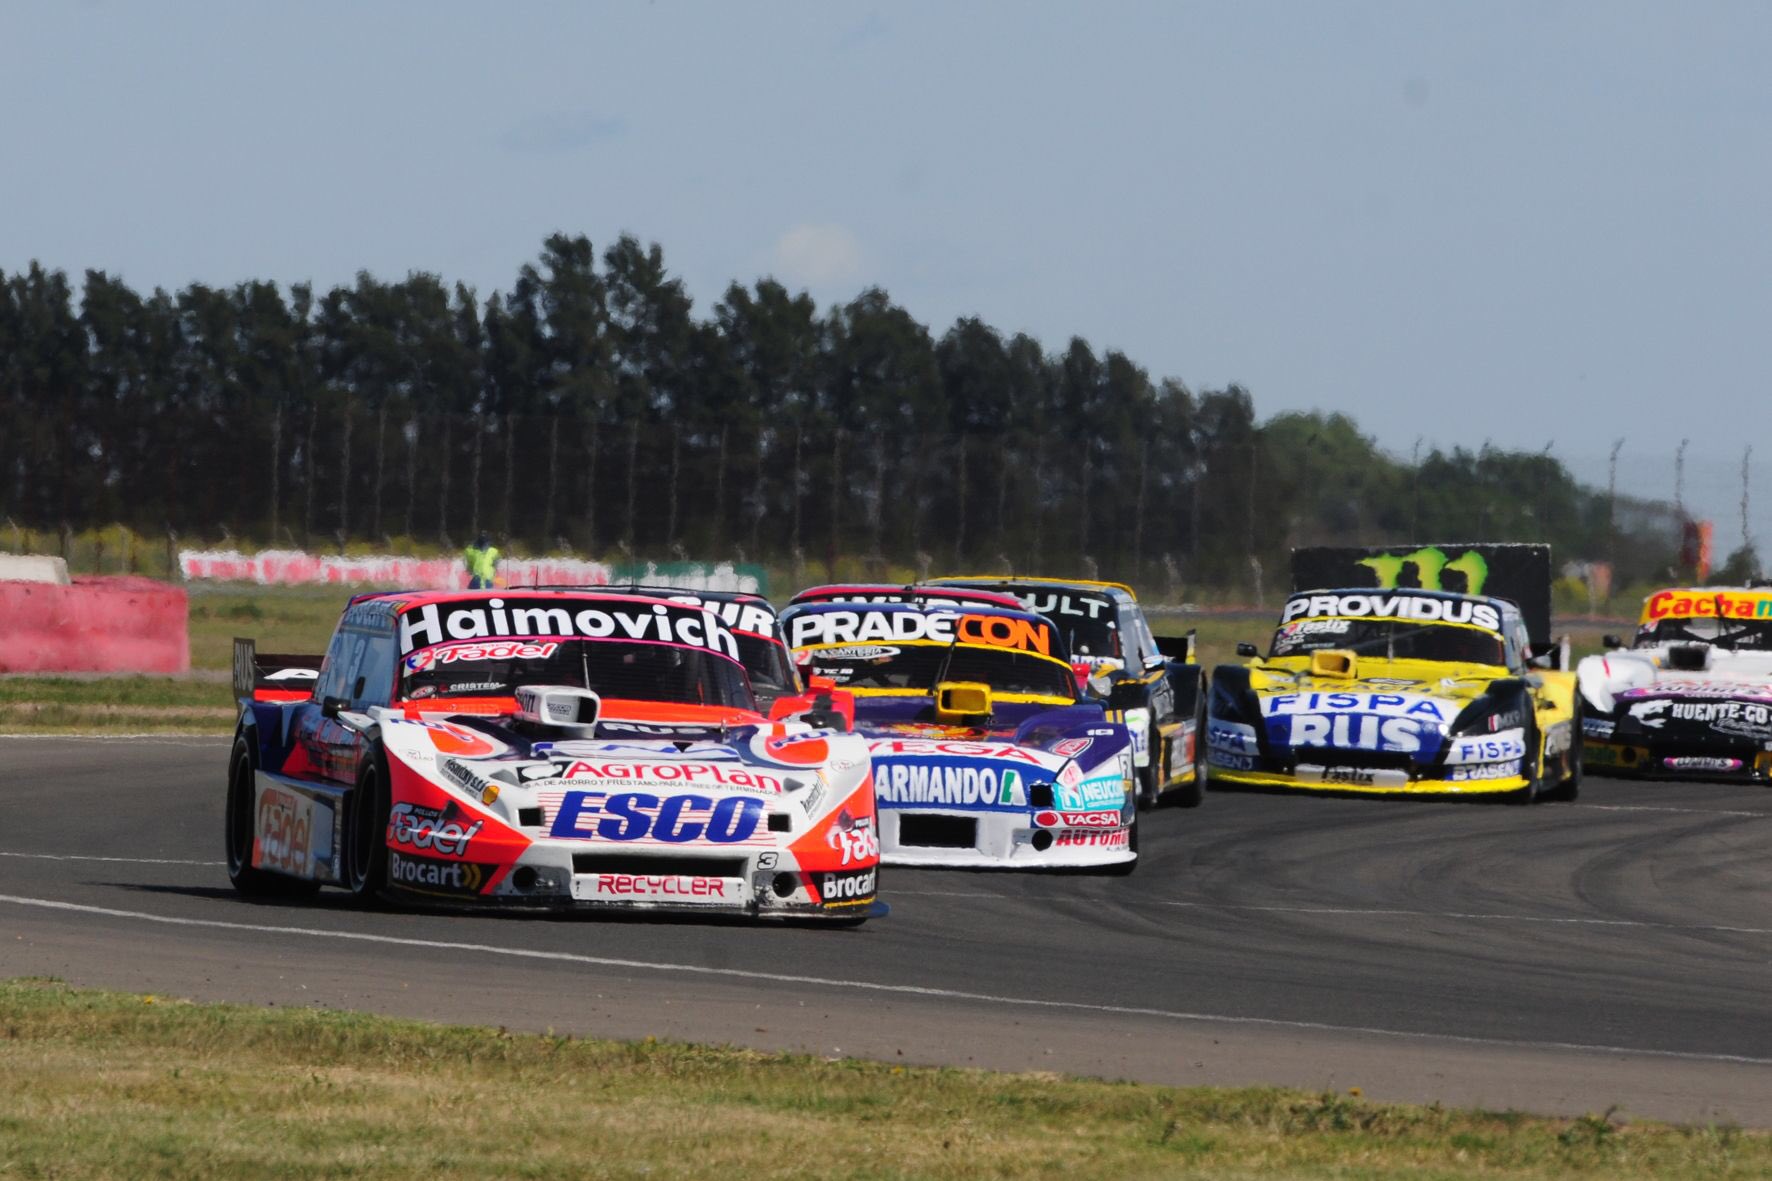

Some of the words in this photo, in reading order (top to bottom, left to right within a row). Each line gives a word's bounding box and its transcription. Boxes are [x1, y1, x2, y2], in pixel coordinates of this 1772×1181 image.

[400, 598, 740, 661] Haimovich
[1283, 595, 1500, 630] PROVIDUS
[1270, 693, 1444, 721] FISPA
[1289, 714, 1421, 752] RUS
[875, 765, 998, 805] ARMANDO
[387, 803, 484, 856] Fadel
[550, 791, 765, 843] ESCO
[1067, 814, 1118, 825] TACSA
[392, 852, 463, 888] Brocart
[757, 852, 779, 870] 3
